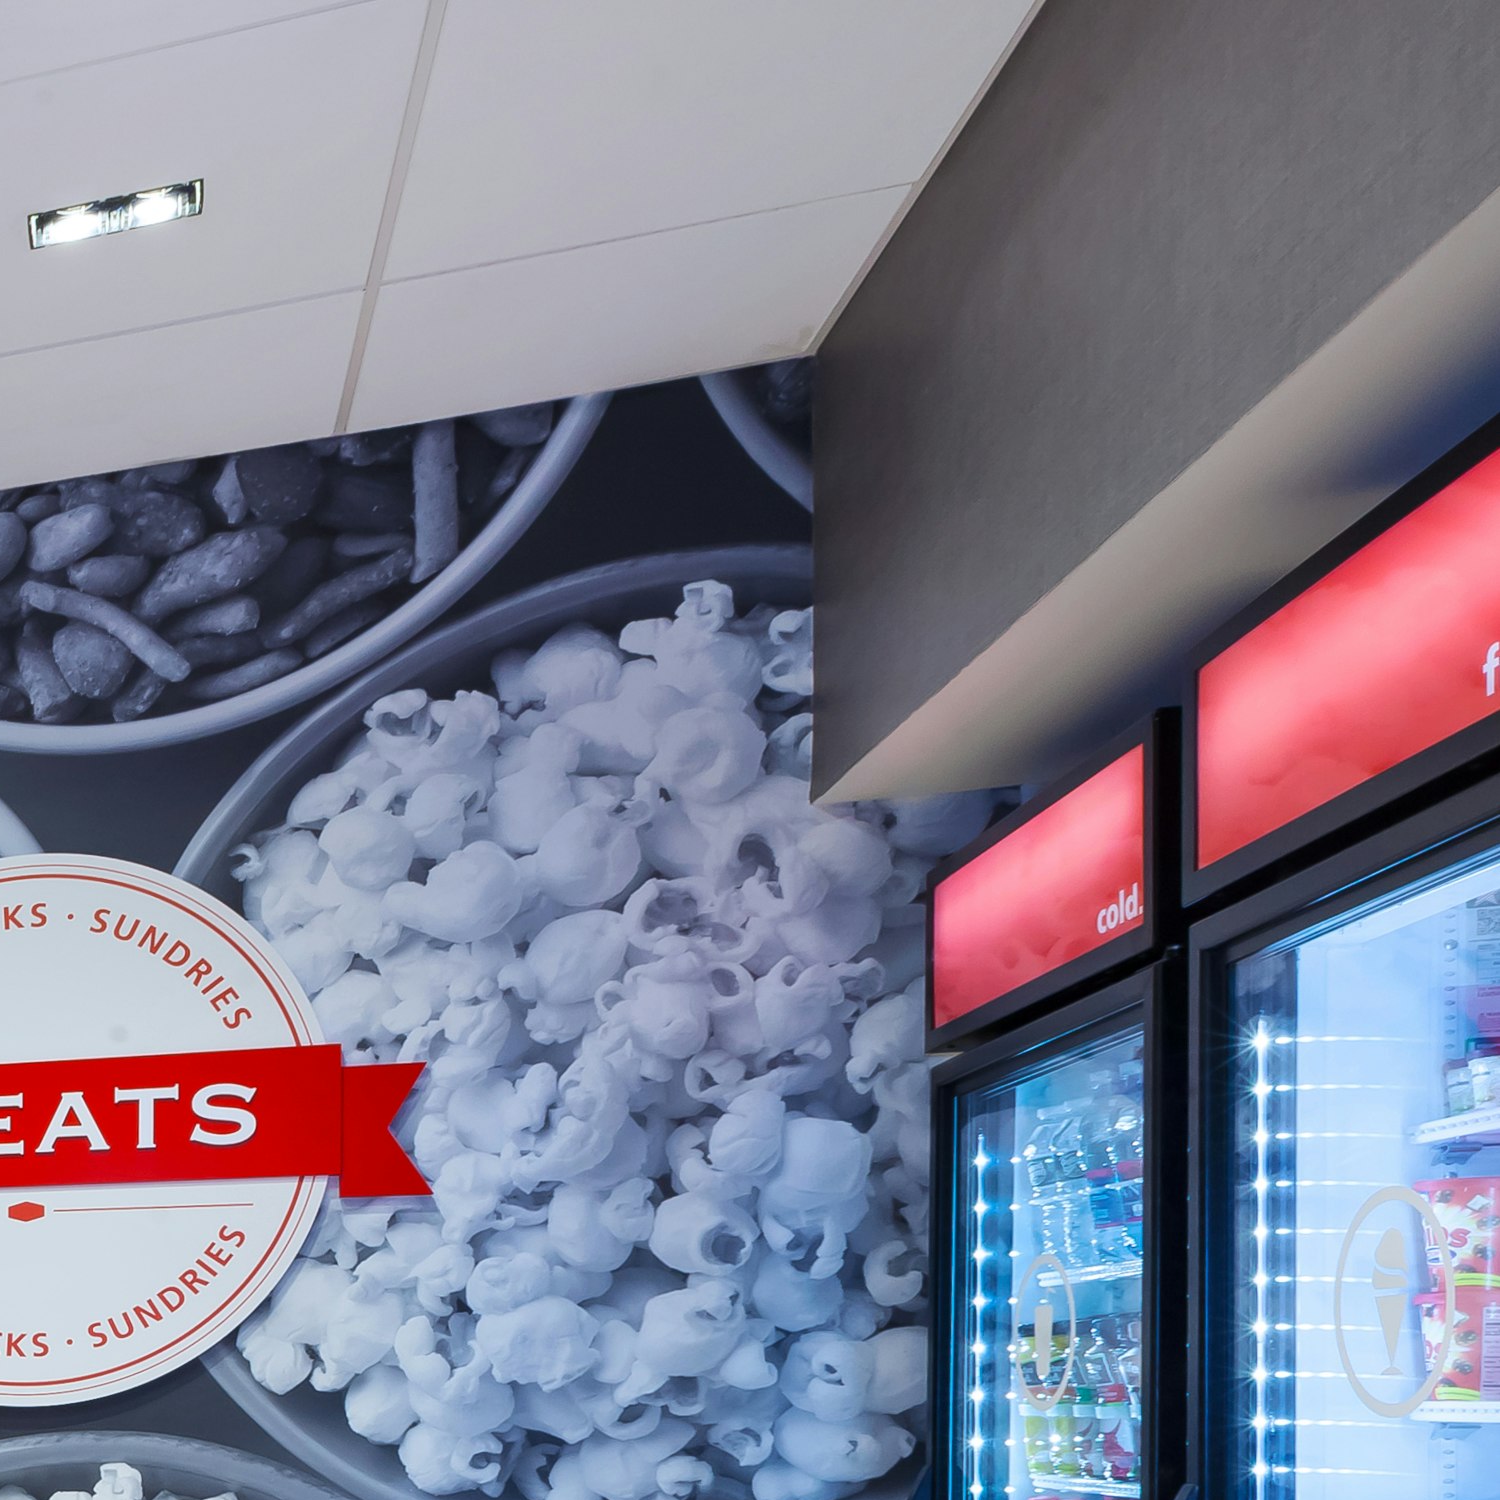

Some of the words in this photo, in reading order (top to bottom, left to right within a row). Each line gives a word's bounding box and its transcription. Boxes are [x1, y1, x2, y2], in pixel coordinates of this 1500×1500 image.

[88, 907, 254, 1032] SUNDRIES
[1096, 882, 1144, 934] cold.
[87, 1222, 247, 1349] SUNDRIES
